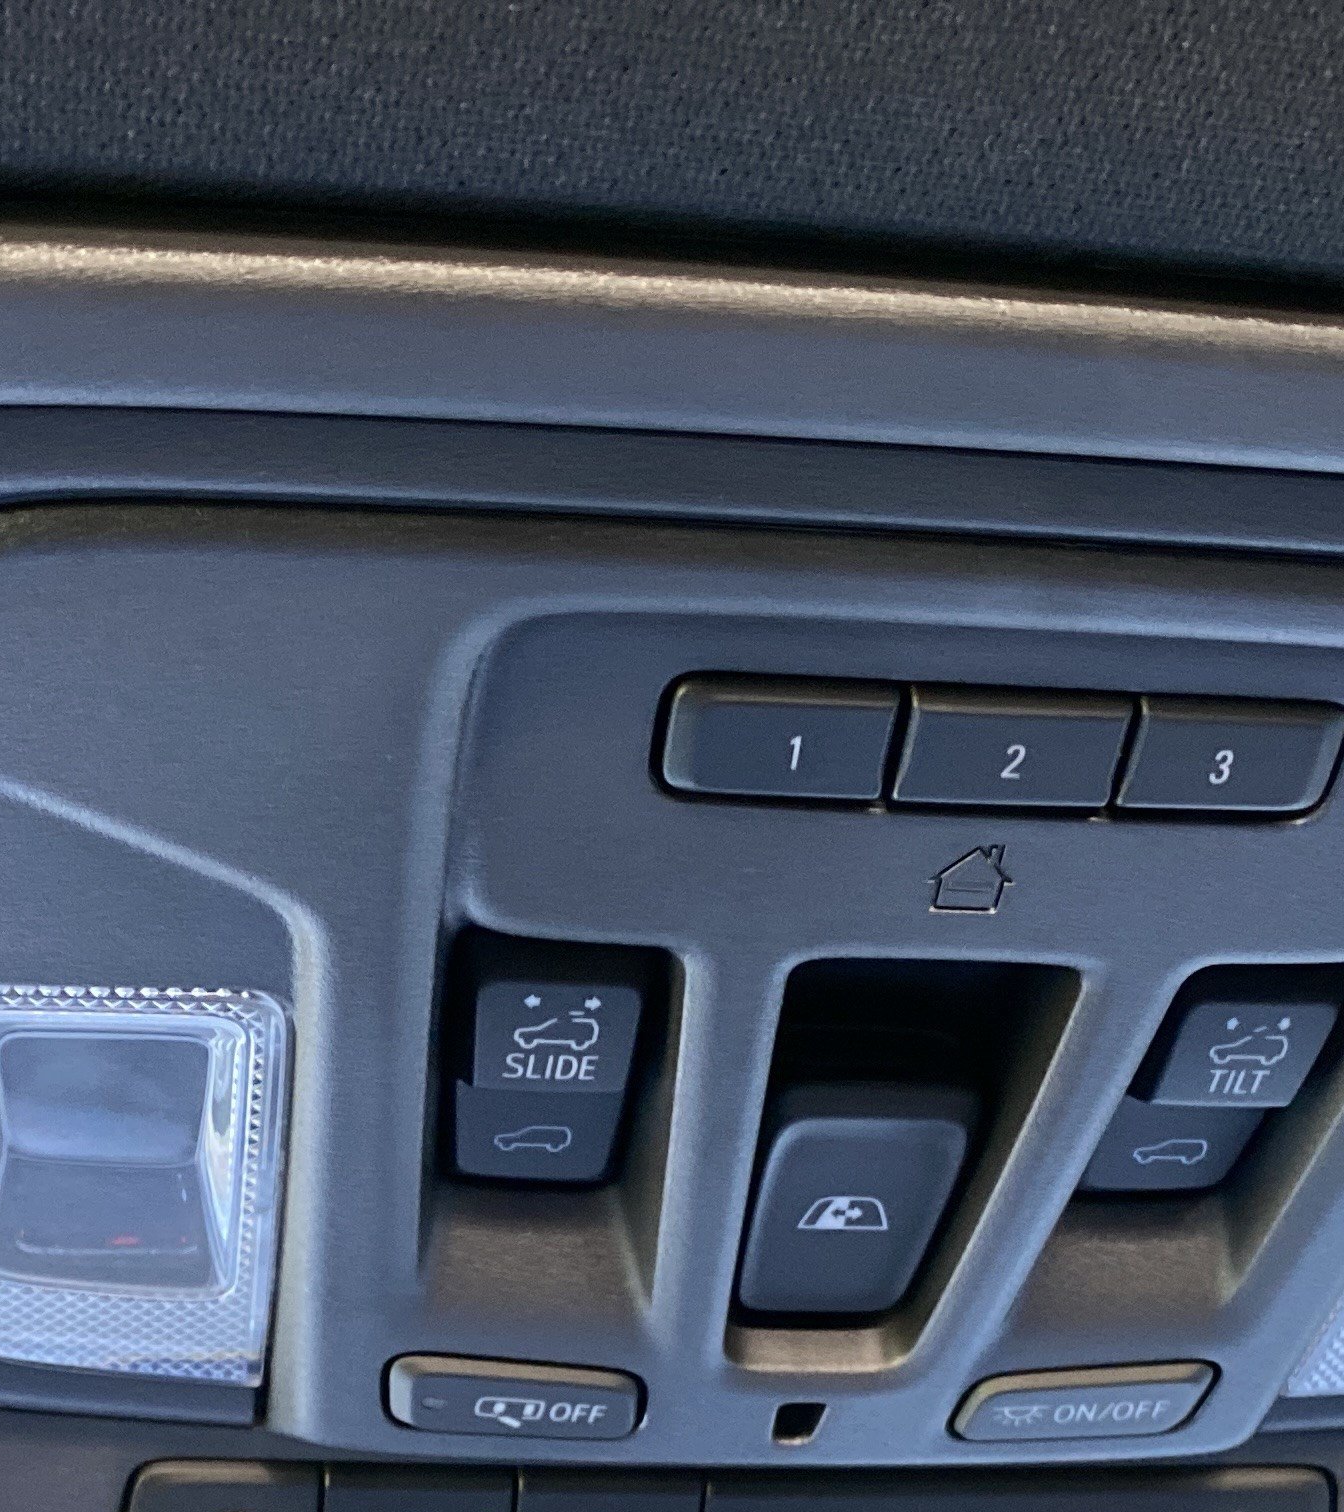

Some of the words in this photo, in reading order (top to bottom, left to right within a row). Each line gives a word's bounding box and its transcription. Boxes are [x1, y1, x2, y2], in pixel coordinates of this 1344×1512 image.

[787, 735, 803, 771] 1
[1000, 744, 1027, 780] 2
[1208, 749, 1235, 785] 3
[502, 1053, 600, 1082] SLIDE
[1208, 1068, 1271, 1095] TILT
[548, 1402, 608, 1425] OFF
[1052, 1400, 1171, 1424] ON/OFF
